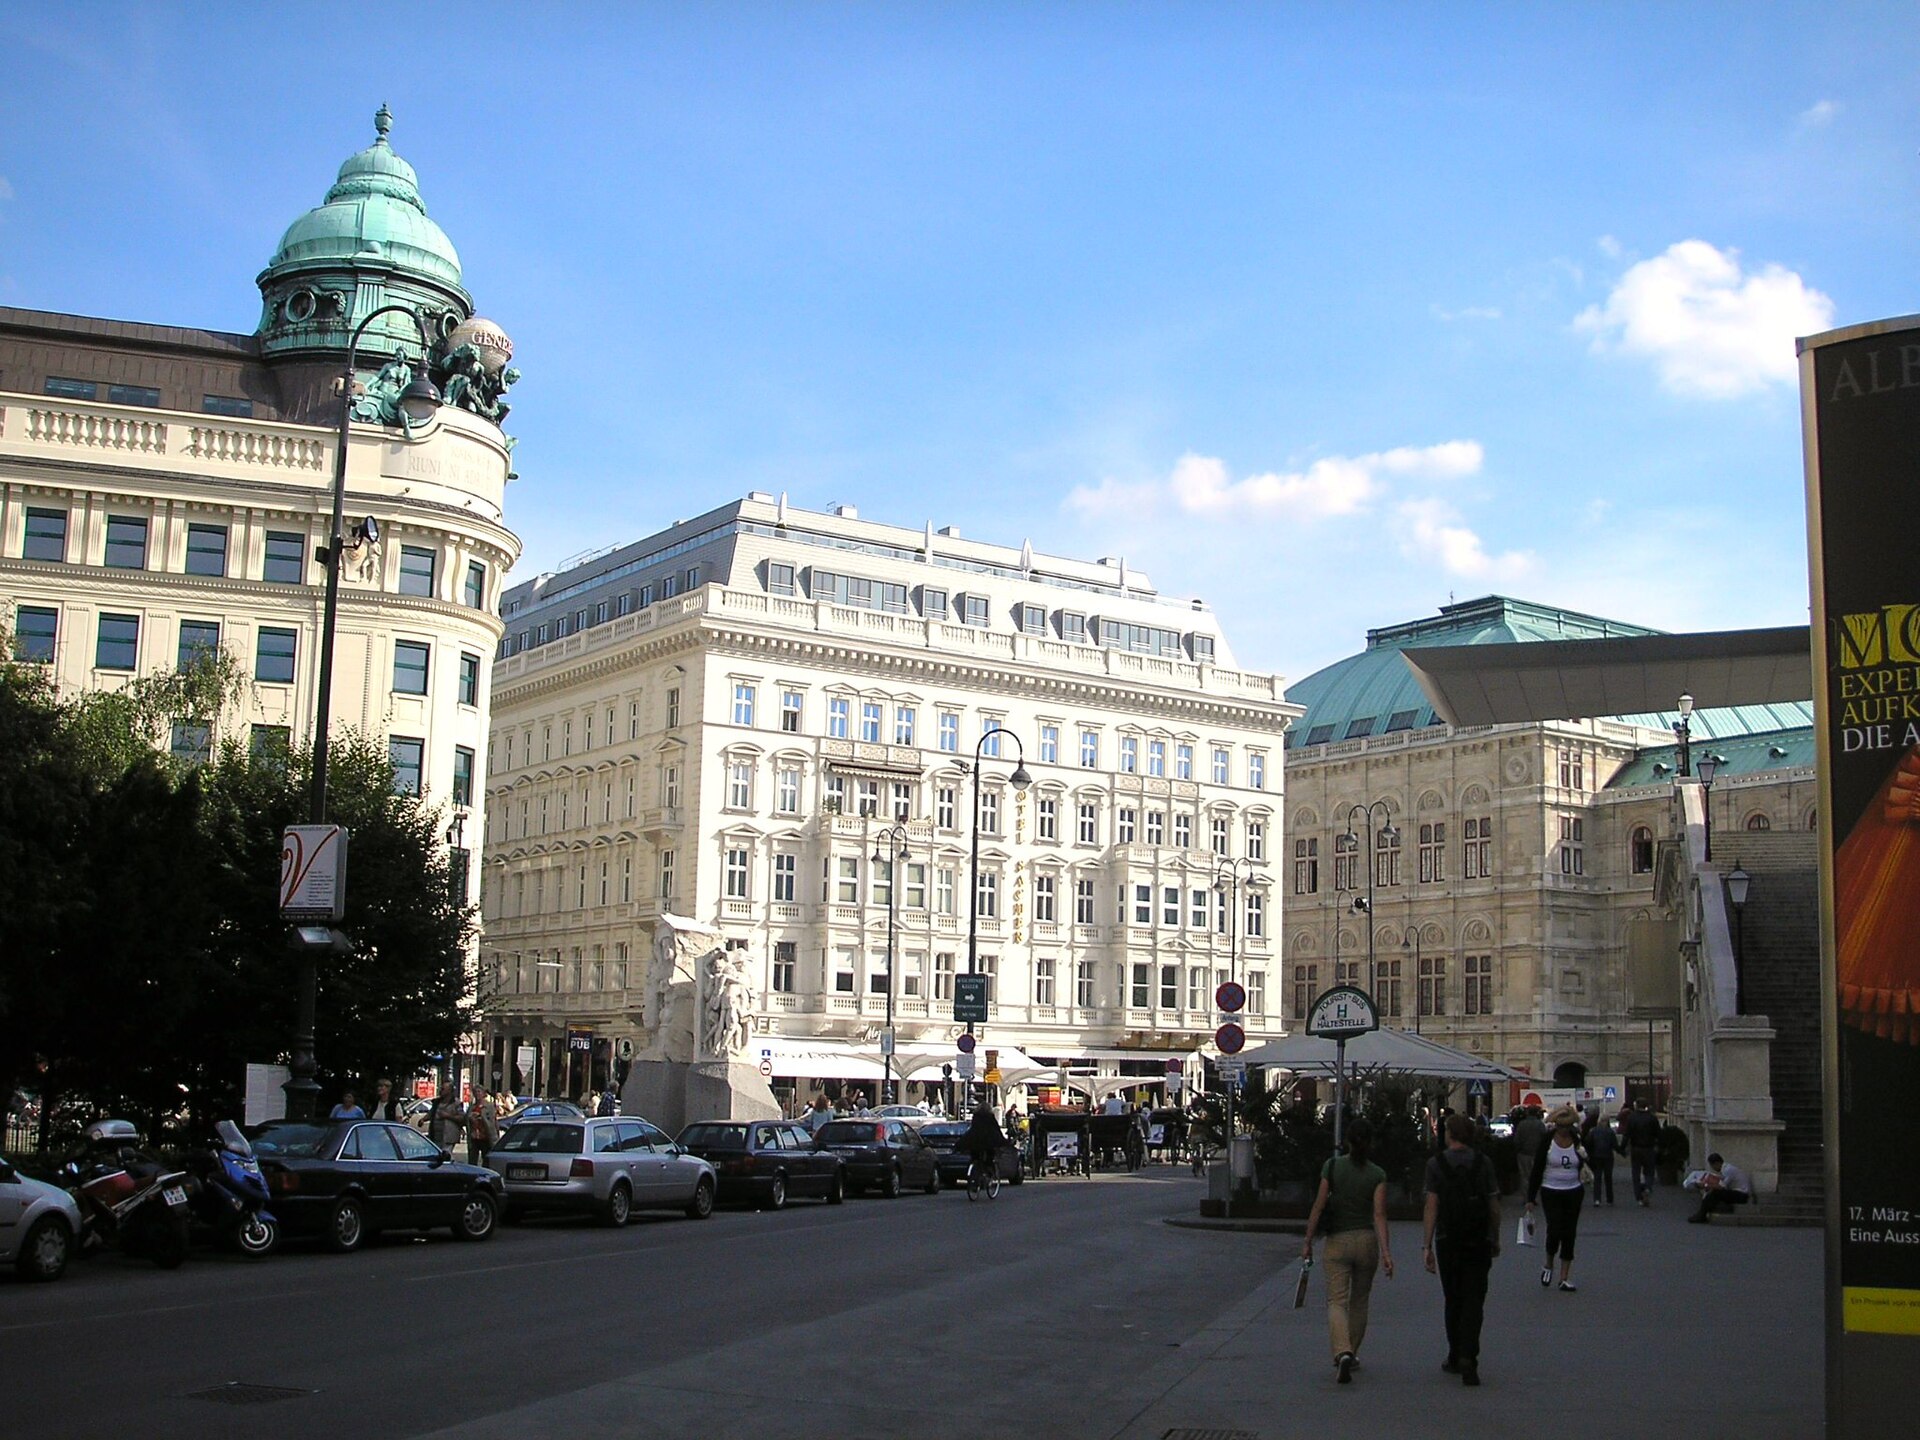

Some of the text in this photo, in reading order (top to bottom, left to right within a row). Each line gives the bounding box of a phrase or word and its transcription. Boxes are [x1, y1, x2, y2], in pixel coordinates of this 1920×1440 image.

[1840, 667, 1920, 699] EXPE
[1842, 724, 1893, 753] DIE
[1319, 993, 1365, 1013] TOURIST-BUS
[1336, 1004, 1347, 1018] H
[1317, 1018, 1366, 1029] HALTESTELLE
[570, 1040, 590, 1050] PUB
[1849, 1206, 1865, 1221] 17.
[1872, 1207, 1910, 1222] März
[1849, 1228, 1920, 1244] Eine Auss
